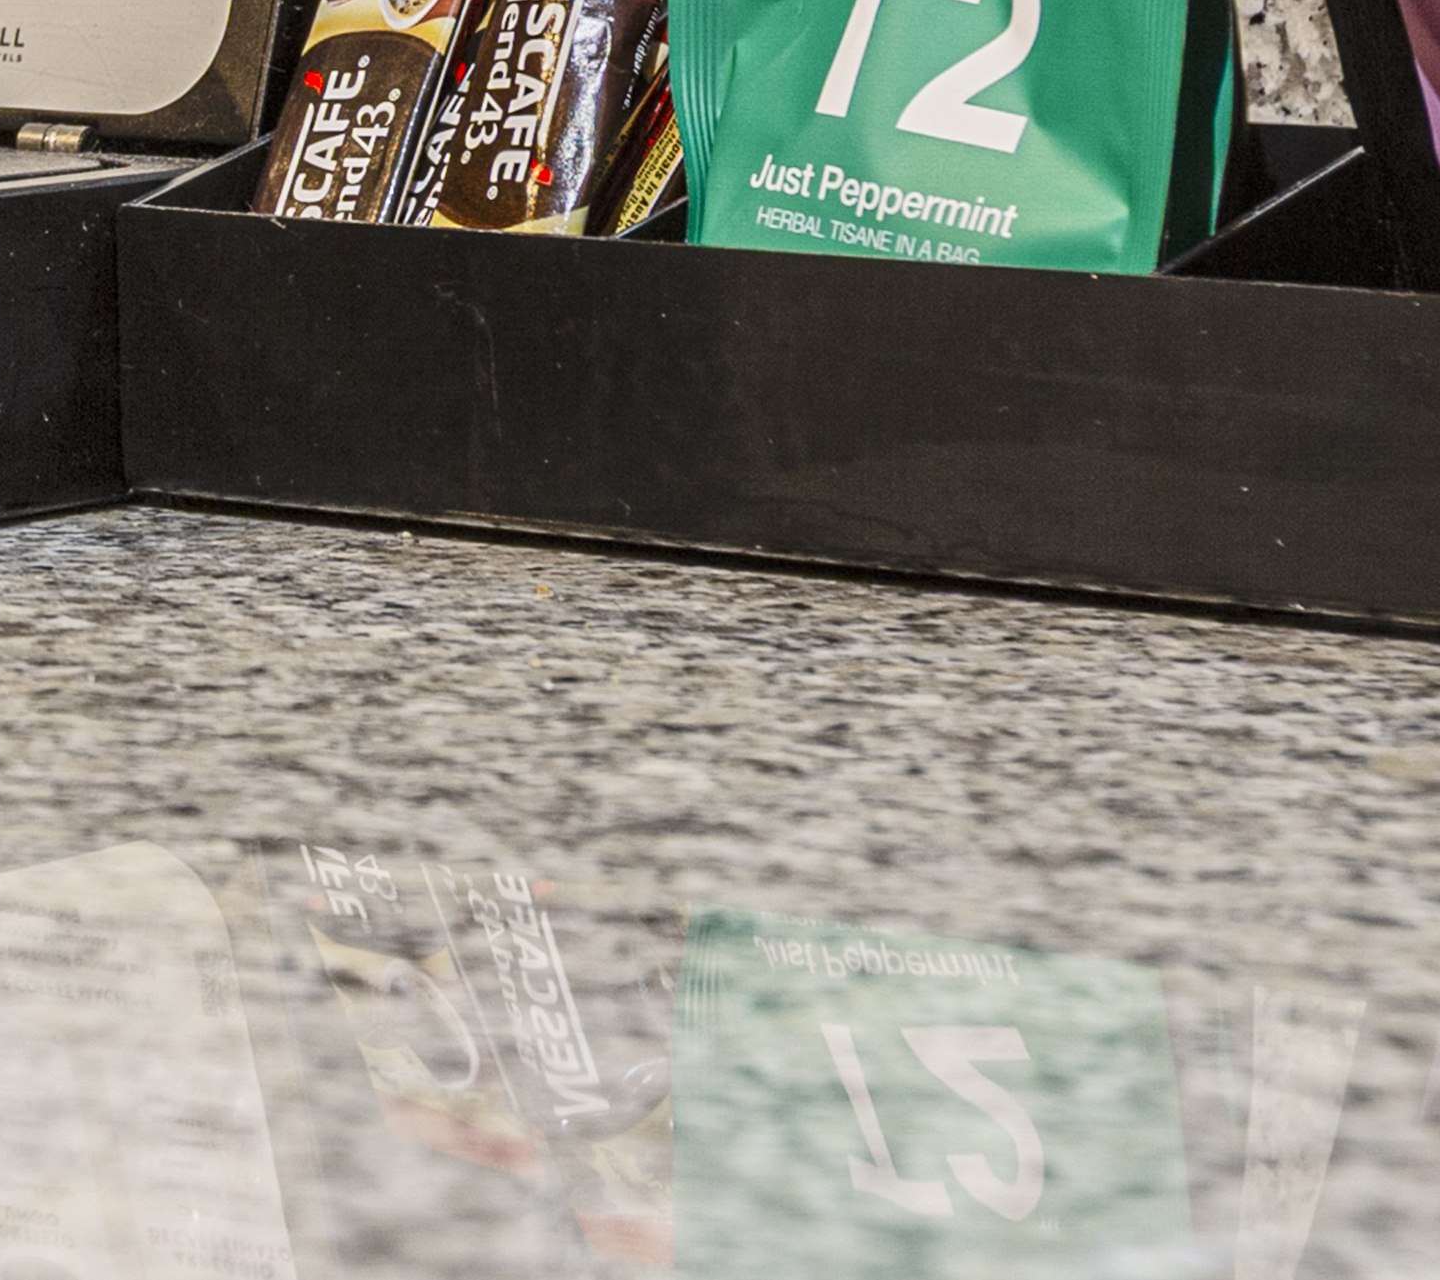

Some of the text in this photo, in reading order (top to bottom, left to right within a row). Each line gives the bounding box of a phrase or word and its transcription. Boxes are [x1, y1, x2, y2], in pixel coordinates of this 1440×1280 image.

[465, 93, 505, 149] 43
[750, 154, 1018, 239] Just Peppermint
[756, 205, 981, 265] HERBAL TISANE IN A BAG
